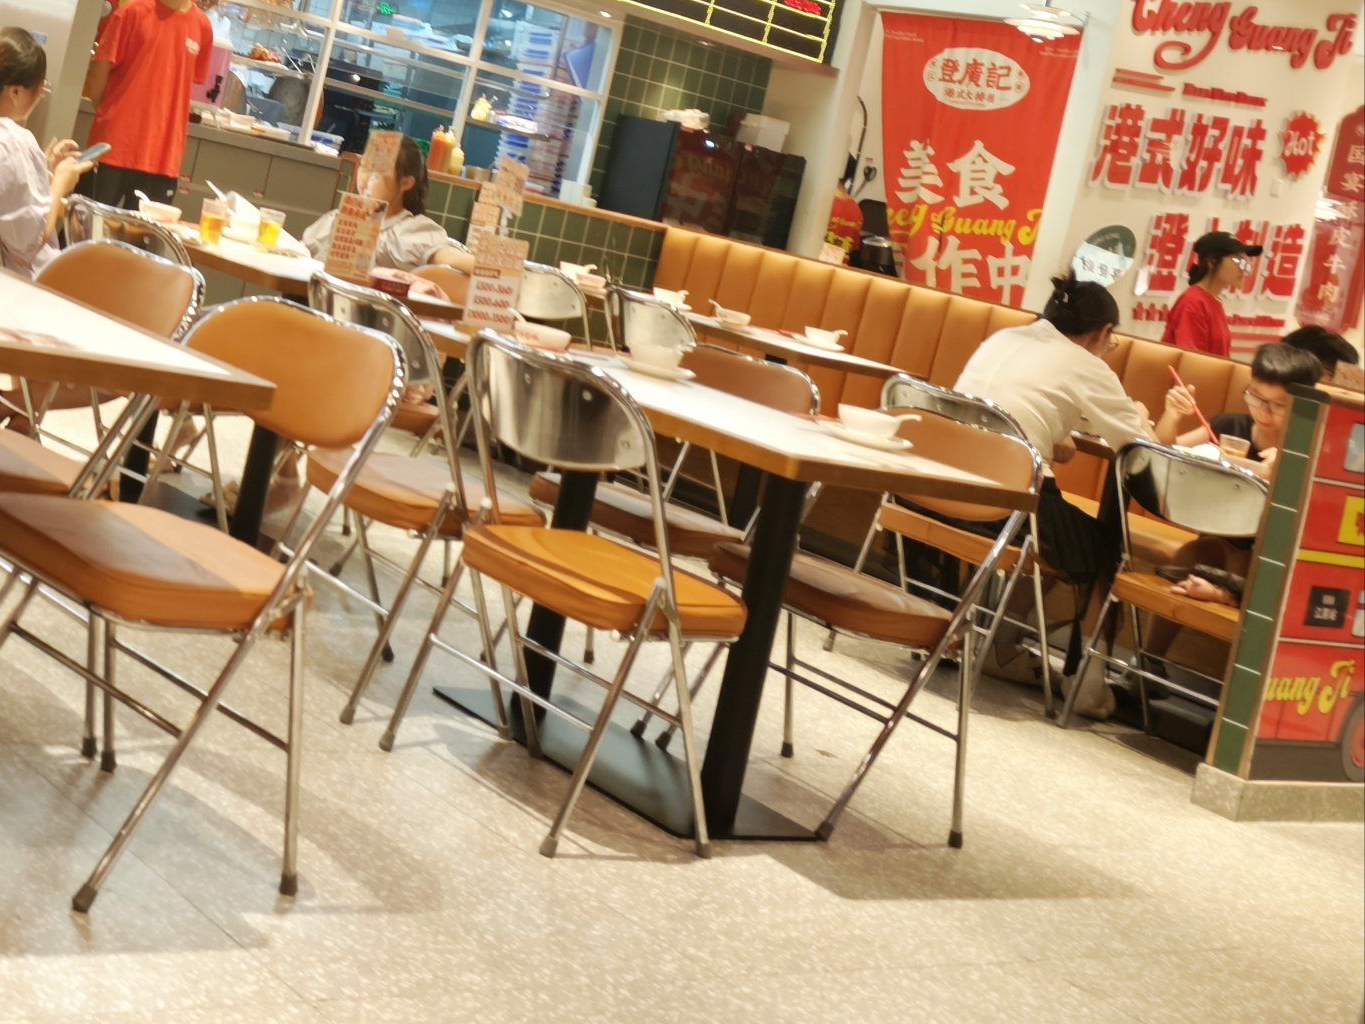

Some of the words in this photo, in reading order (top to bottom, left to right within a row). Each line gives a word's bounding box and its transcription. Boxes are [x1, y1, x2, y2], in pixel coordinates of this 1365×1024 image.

[1229, 6, 1318, 69] Guang
[1314, 13, 1359, 70] Ji
[895, 139, 1016, 211] 美食
[1092, 102, 1268, 198] 港式好味
[1284, 129, 1315, 158] Hot
[910, 235, 1033, 307] 作中
[1264, 675, 1321, 717] uang
